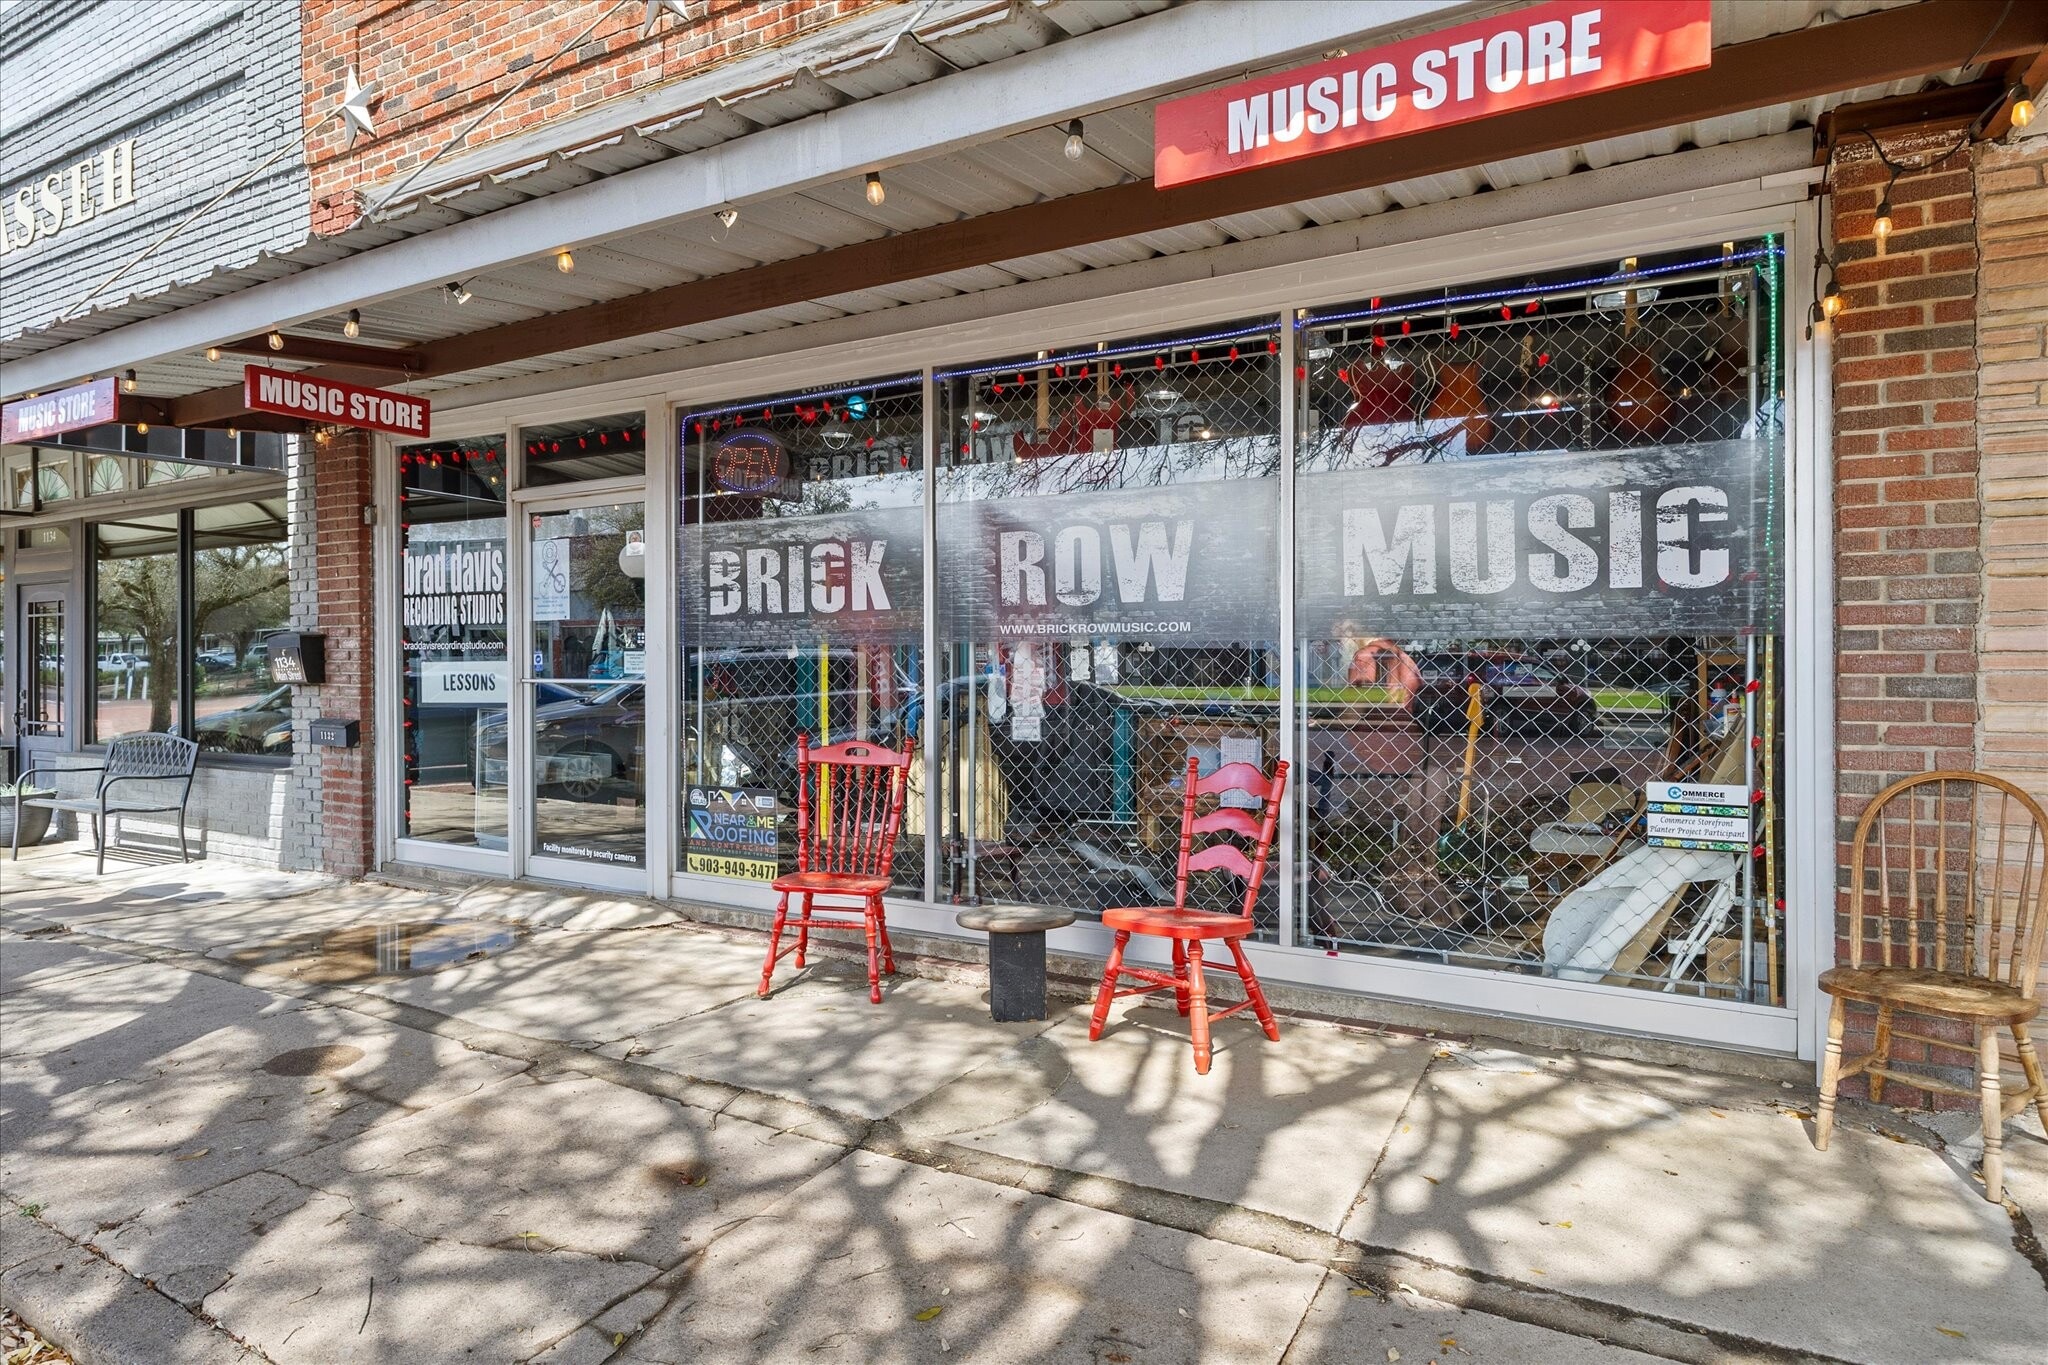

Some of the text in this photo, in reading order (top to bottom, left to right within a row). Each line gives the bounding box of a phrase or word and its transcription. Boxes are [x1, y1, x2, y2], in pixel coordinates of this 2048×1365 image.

[1227, 9, 1602, 154] MUSIC STORE
[18, 389, 96, 432] MUSIC STORE
[259, 374, 423, 431] MUSIC STORE
[715, 446, 780, 479] OPEN
[43, 531, 57, 543] 1134
[709, 485, 1730, 616] BRICK ROW MUSIC
[404, 542, 503, 596] brad davis
[404, 595, 458, 626] RECORDING
[460, 593, 503, 625] STUDIOS
[1000, 621, 1191, 635] WWW.BRICKROWMUSIC.COM
[404, 640, 504, 652] braddavisrecordingstudio.com
[275, 656, 296, 668] 1134
[443, 673, 496, 691] LESSONS
[714, 813, 775, 829] NEAR ME
[1660, 816, 1734, 829] Commerce Storefront
[1649, 825, 1745, 839] Planter Project Participant
[543, 842, 637, 862] Facility monitored by security cameras
[689, 839, 776, 854] AND CONTRACTING
[699, 858, 776, 880] 903-949-3477
